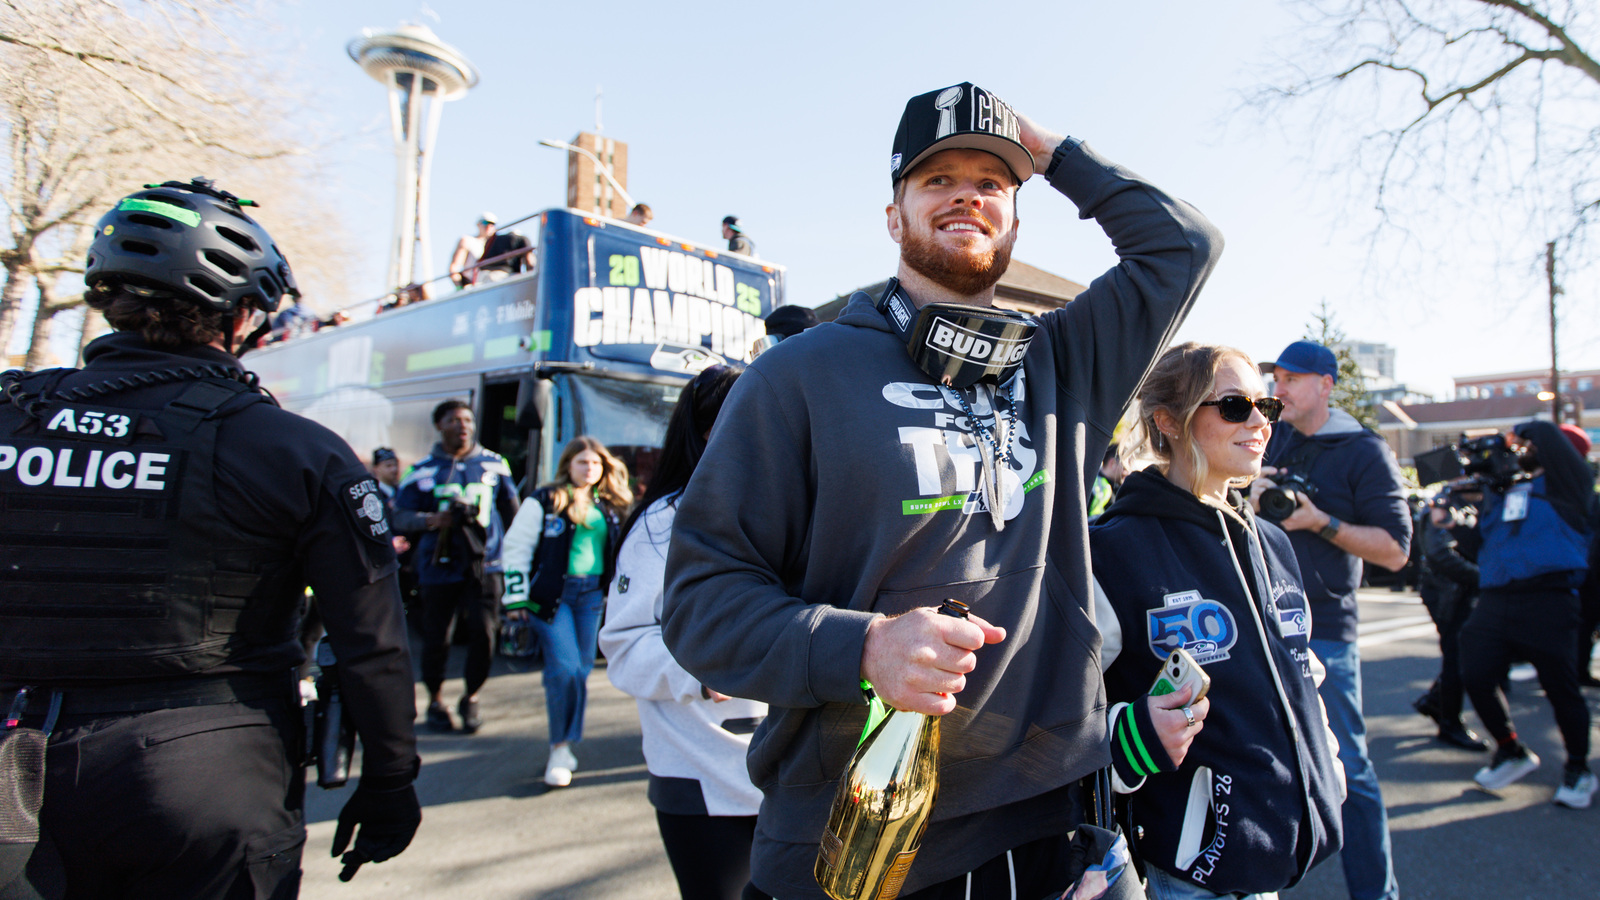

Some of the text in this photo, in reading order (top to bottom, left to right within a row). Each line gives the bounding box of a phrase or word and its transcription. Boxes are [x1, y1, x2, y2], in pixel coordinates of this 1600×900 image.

[971, 86, 1020, 142] CHA
[609, 246, 762, 317] 20 WORLD 25
[574, 286, 767, 365] CHAMPION
[932, 324, 1031, 362] BUD LIGH
[47, 408, 131, 437] A53
[0, 445, 171, 490] POLICE
[349, 480, 378, 499] SEATTLE
[1151, 602, 1234, 659] 50
[1192, 774, 1233, 885] PLAYOFFS '26
